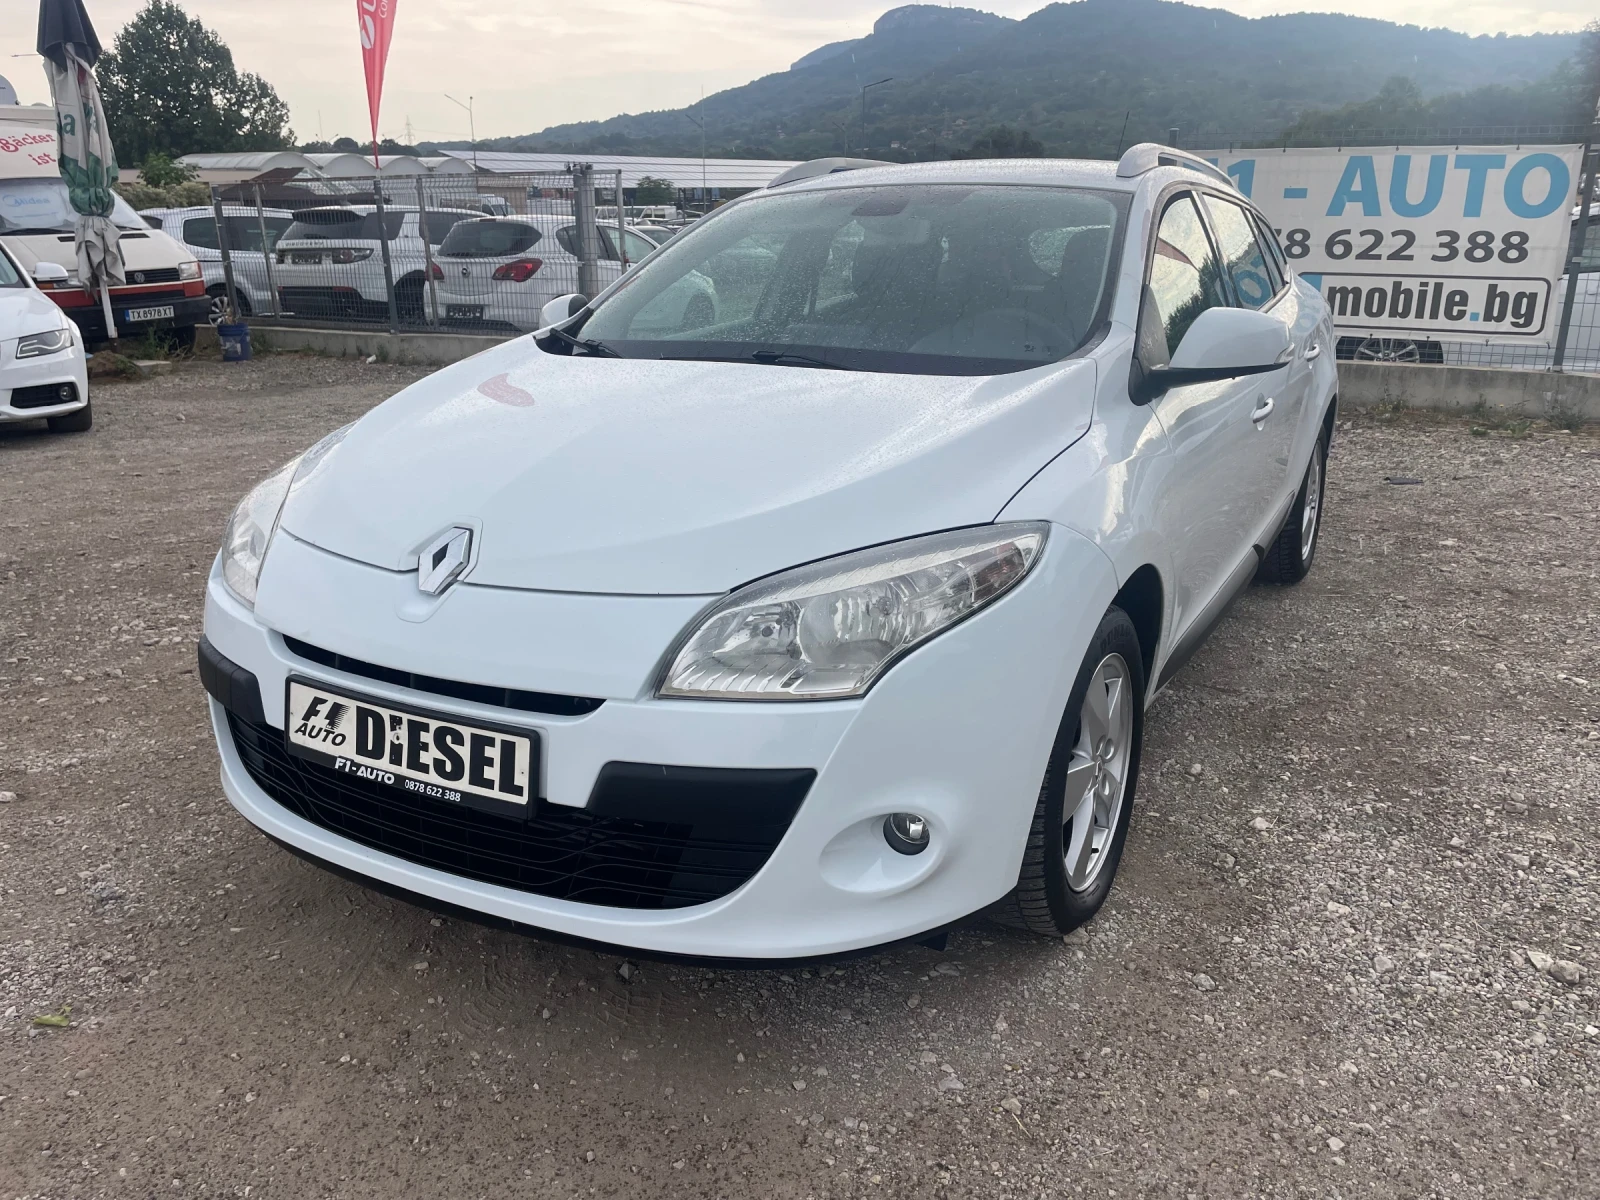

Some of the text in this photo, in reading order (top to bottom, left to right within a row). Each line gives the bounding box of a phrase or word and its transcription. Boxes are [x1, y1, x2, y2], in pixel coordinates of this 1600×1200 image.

[0, 133, 56, 152] Bäcker
[28, 152, 56, 166] ist
[1325, 153, 1571, 219] AUTO
[1325, 229, 1417, 261] 622
[1431, 230, 1530, 263] 388
[131, 307, 173, 320] TX 8978 XT
[1327, 281, 1539, 329] mobile.bg
[294, 722, 347, 746] AUTO
[356, 705, 525, 797] DIESEL
[404, 779, 425, 793] 0878
[426, 785, 443, 797] 622
[443, 790, 461, 802] 388
